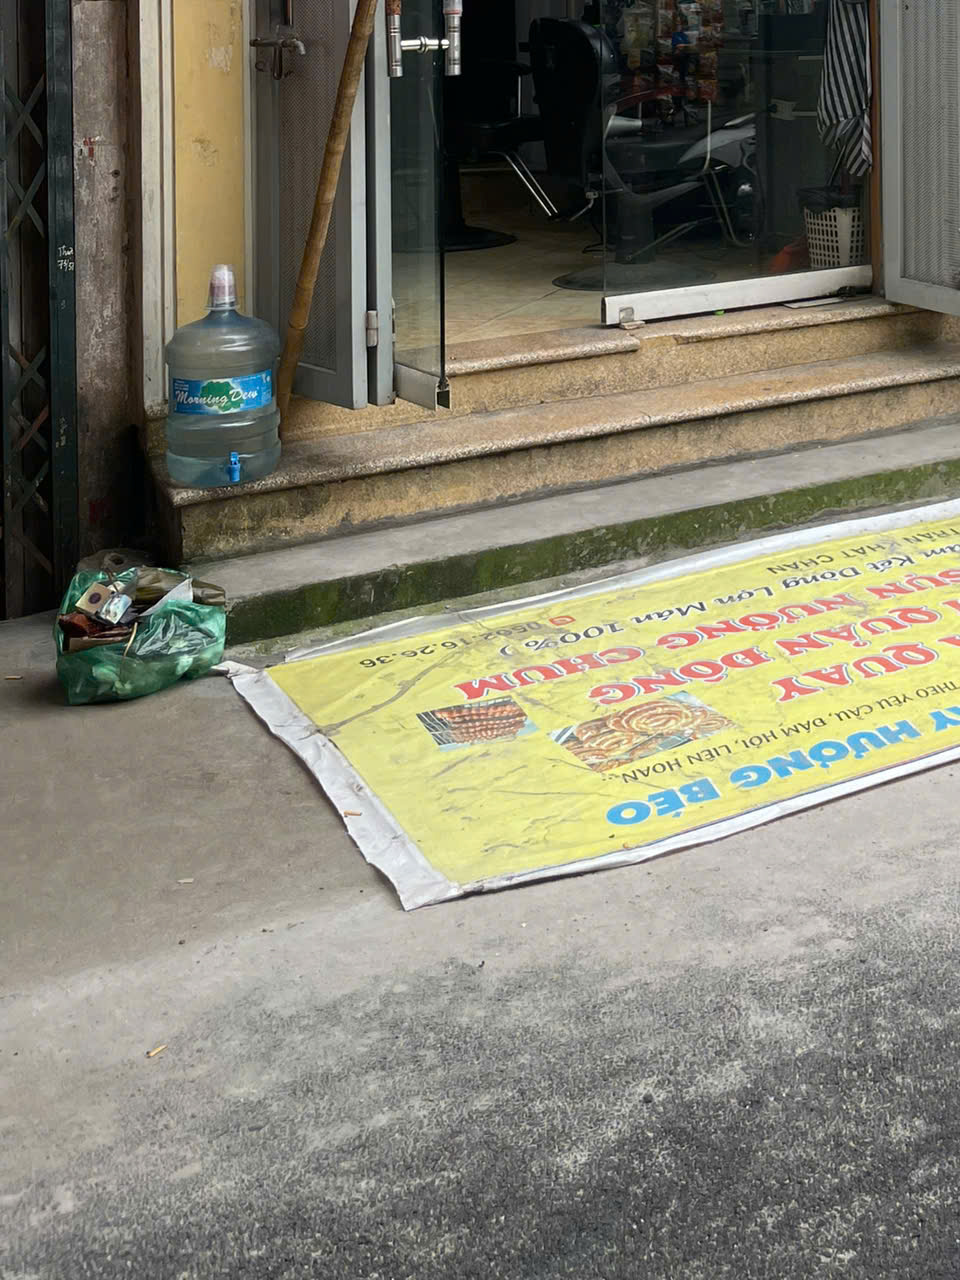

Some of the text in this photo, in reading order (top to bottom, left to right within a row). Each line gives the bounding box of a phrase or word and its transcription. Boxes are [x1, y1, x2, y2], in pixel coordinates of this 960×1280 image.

[175, 387, 258, 407] Morning Dew
[781, 566, 861, 589] Dòng
[714, 586, 774, 606] Lợn
[656, 593, 868, 650] NƯỚNG
[777, 607, 942, 656] QUẢN
[455, 647, 645, 700] CHUM
[590, 647, 772, 706] ĐÔNG
[773, 643, 939, 701] QUAY
[915, 680, 960, 699] THEO
[875, 693, 914, 710] YÊU
[780, 717, 828, 738] ĐÁM
[686, 744, 736, 765] LIÊN
[730, 721, 919, 789] HƯƠNG
[607, 778, 719, 825] BÉO
